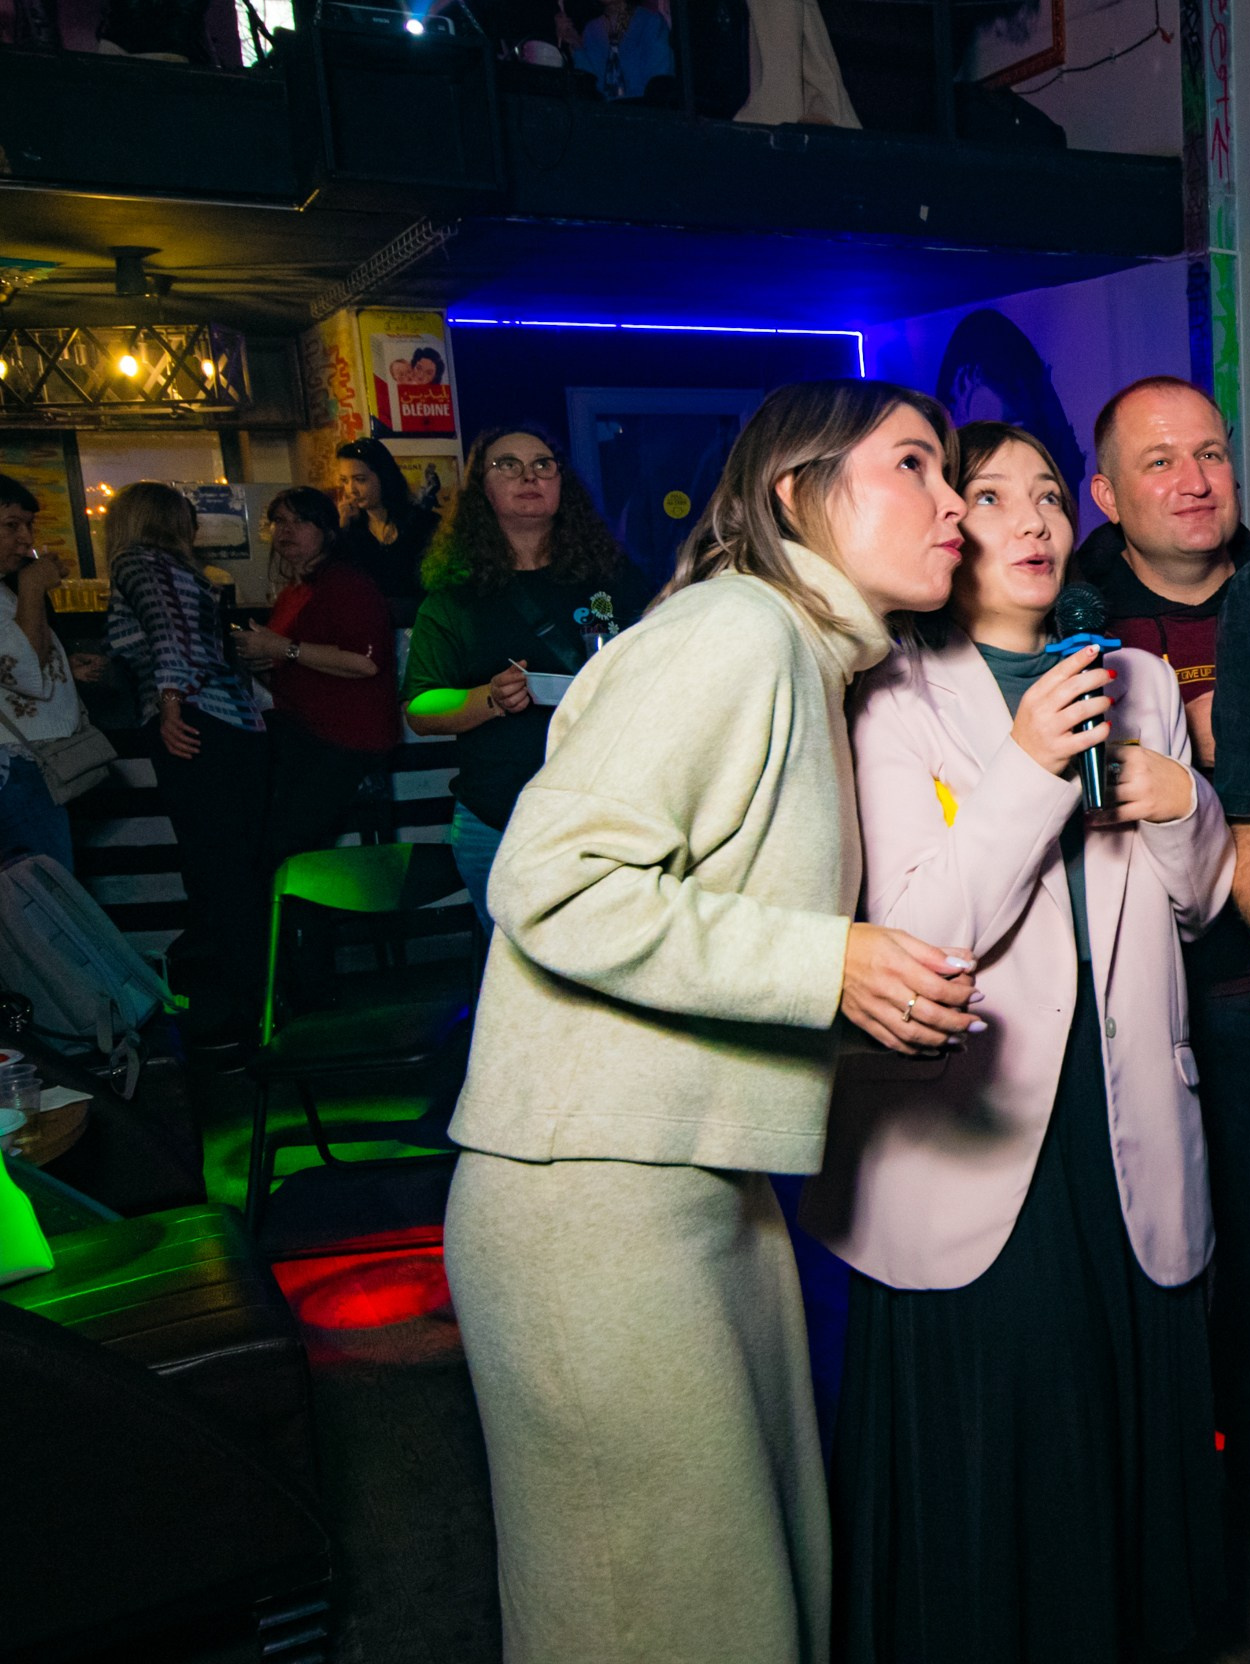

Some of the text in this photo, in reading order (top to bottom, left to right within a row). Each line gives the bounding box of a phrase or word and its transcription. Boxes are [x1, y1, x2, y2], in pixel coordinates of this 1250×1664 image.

[402, 402, 451, 417] BLÉDINE
[1181, 668, 1200, 680] GIVE
[1200, 667, 1213, 678] UP
